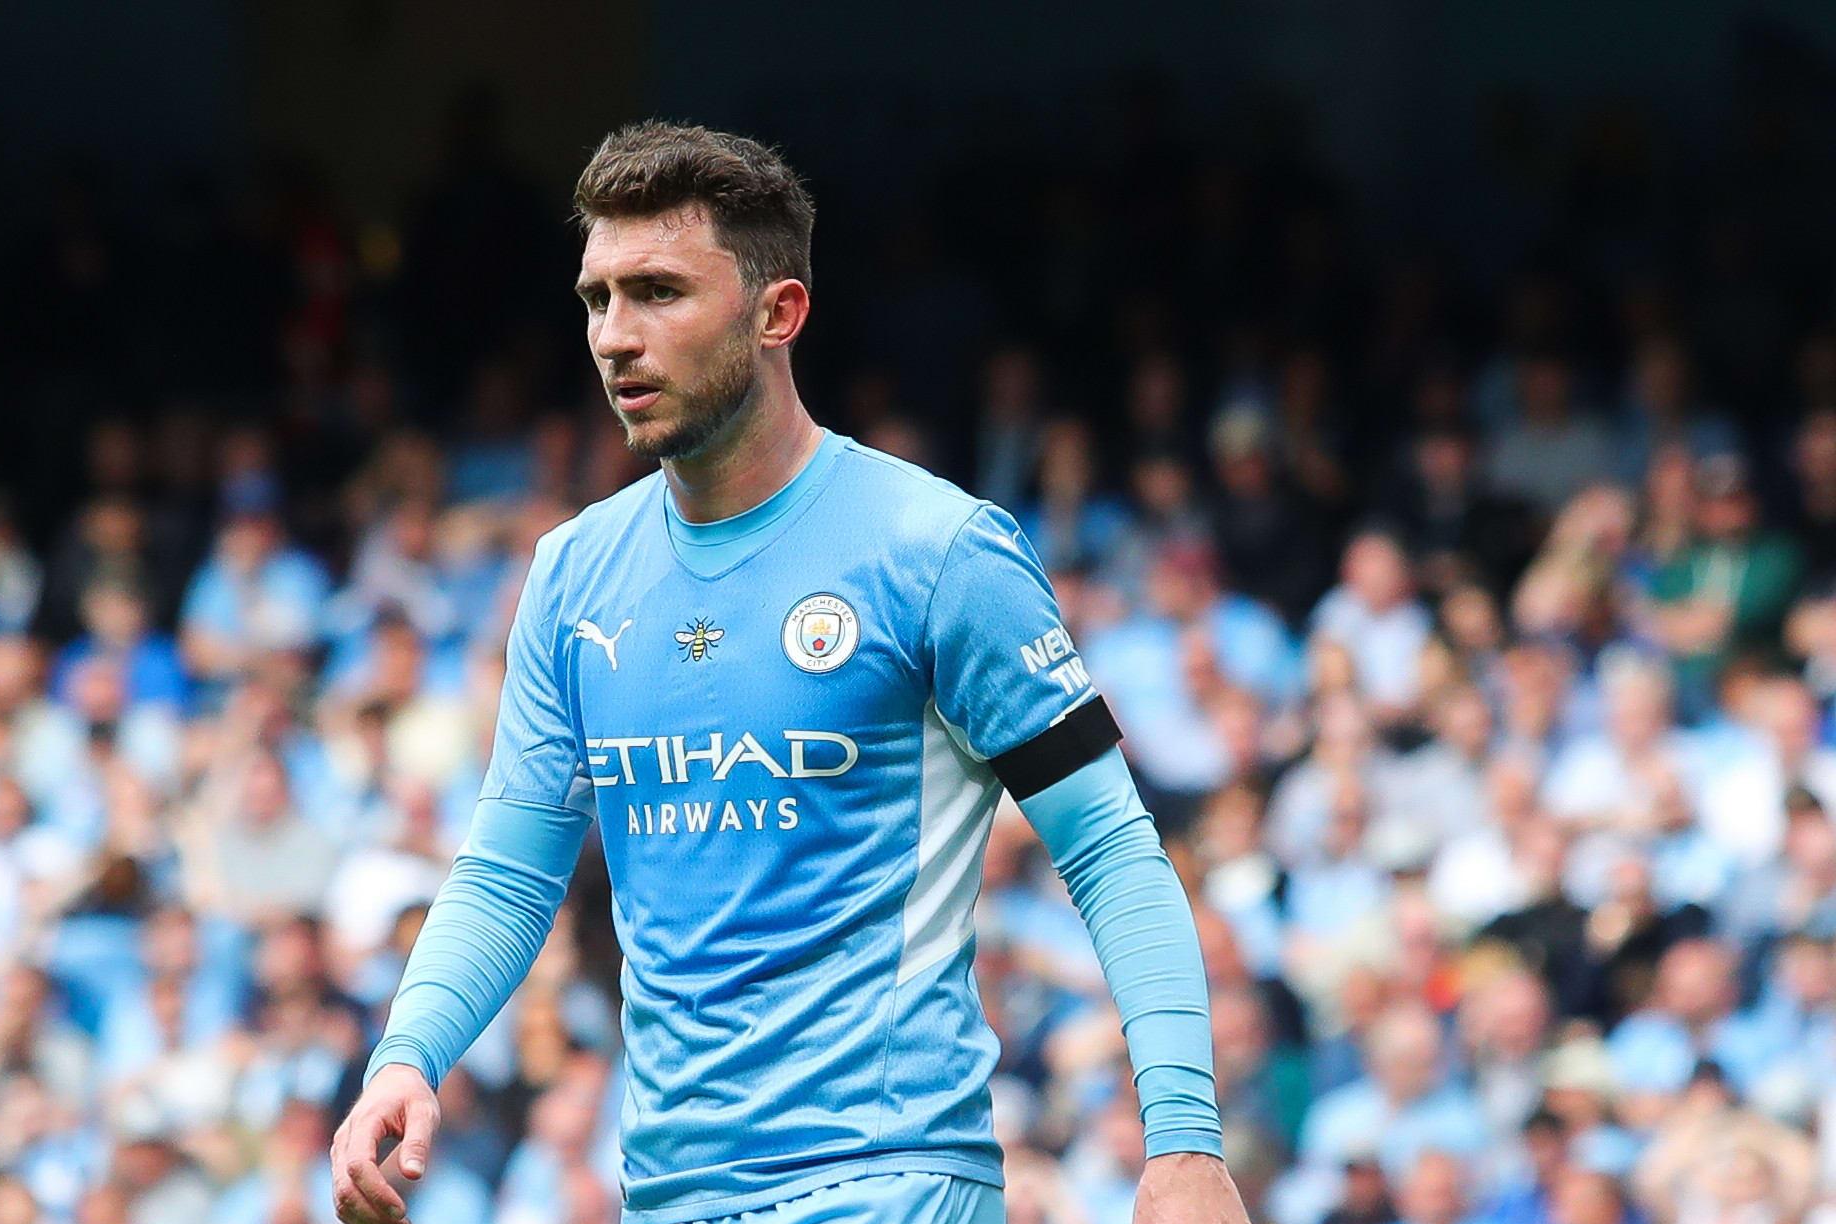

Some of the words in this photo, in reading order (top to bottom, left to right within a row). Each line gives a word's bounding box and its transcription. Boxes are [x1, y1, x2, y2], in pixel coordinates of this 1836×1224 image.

[791, 599, 853, 624] MANCHESTER
[806, 659, 829, 668] CITY
[1019, 627, 1074, 675] NEX
[1048, 656, 1092, 696] TIR
[585, 729, 859, 787] ETIHAD
[627, 796, 799, 836] AIRWAYS
